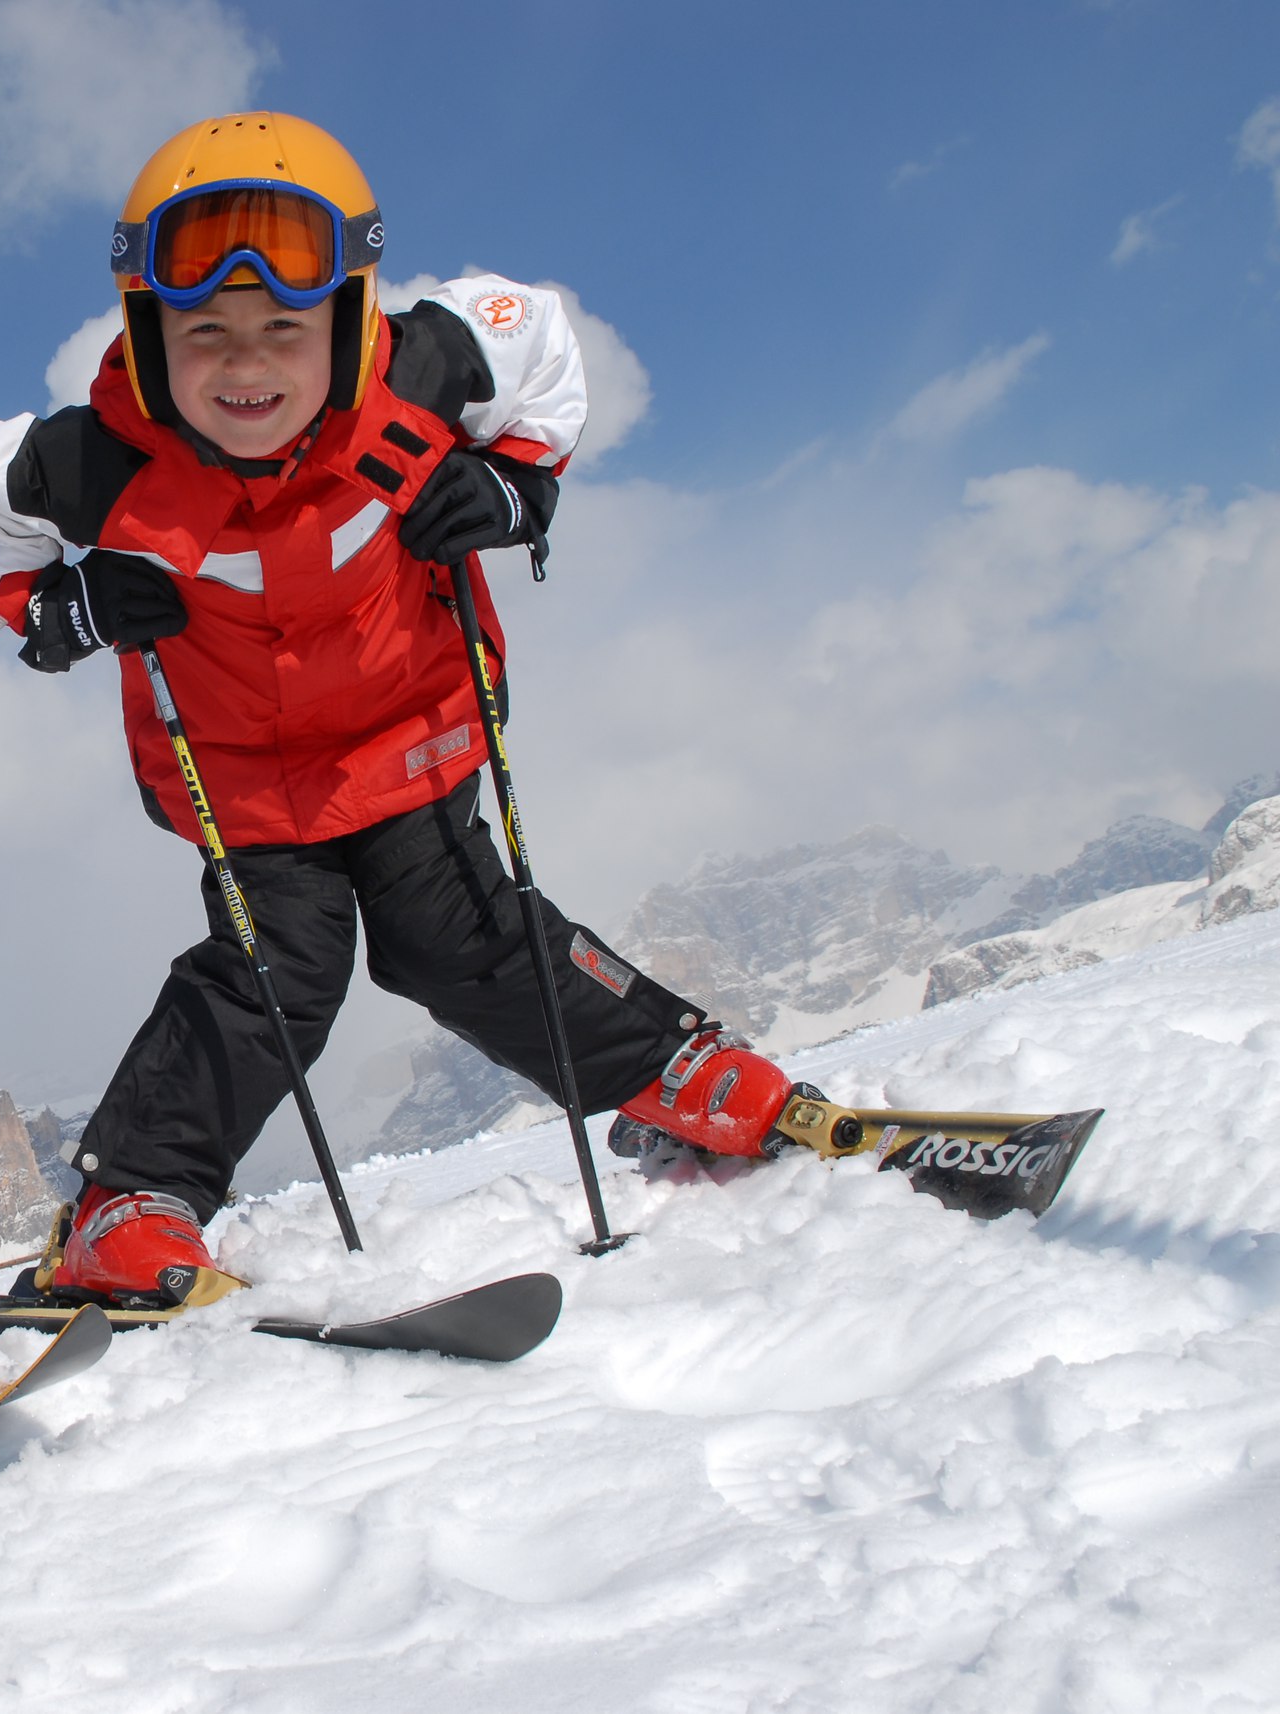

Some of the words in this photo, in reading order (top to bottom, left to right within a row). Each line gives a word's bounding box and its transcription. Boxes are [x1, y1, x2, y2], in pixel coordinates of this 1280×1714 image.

[67, 600, 92, 647] reusch
[172, 736, 209, 811] SCOTT
[199, 811, 225, 859] USA
